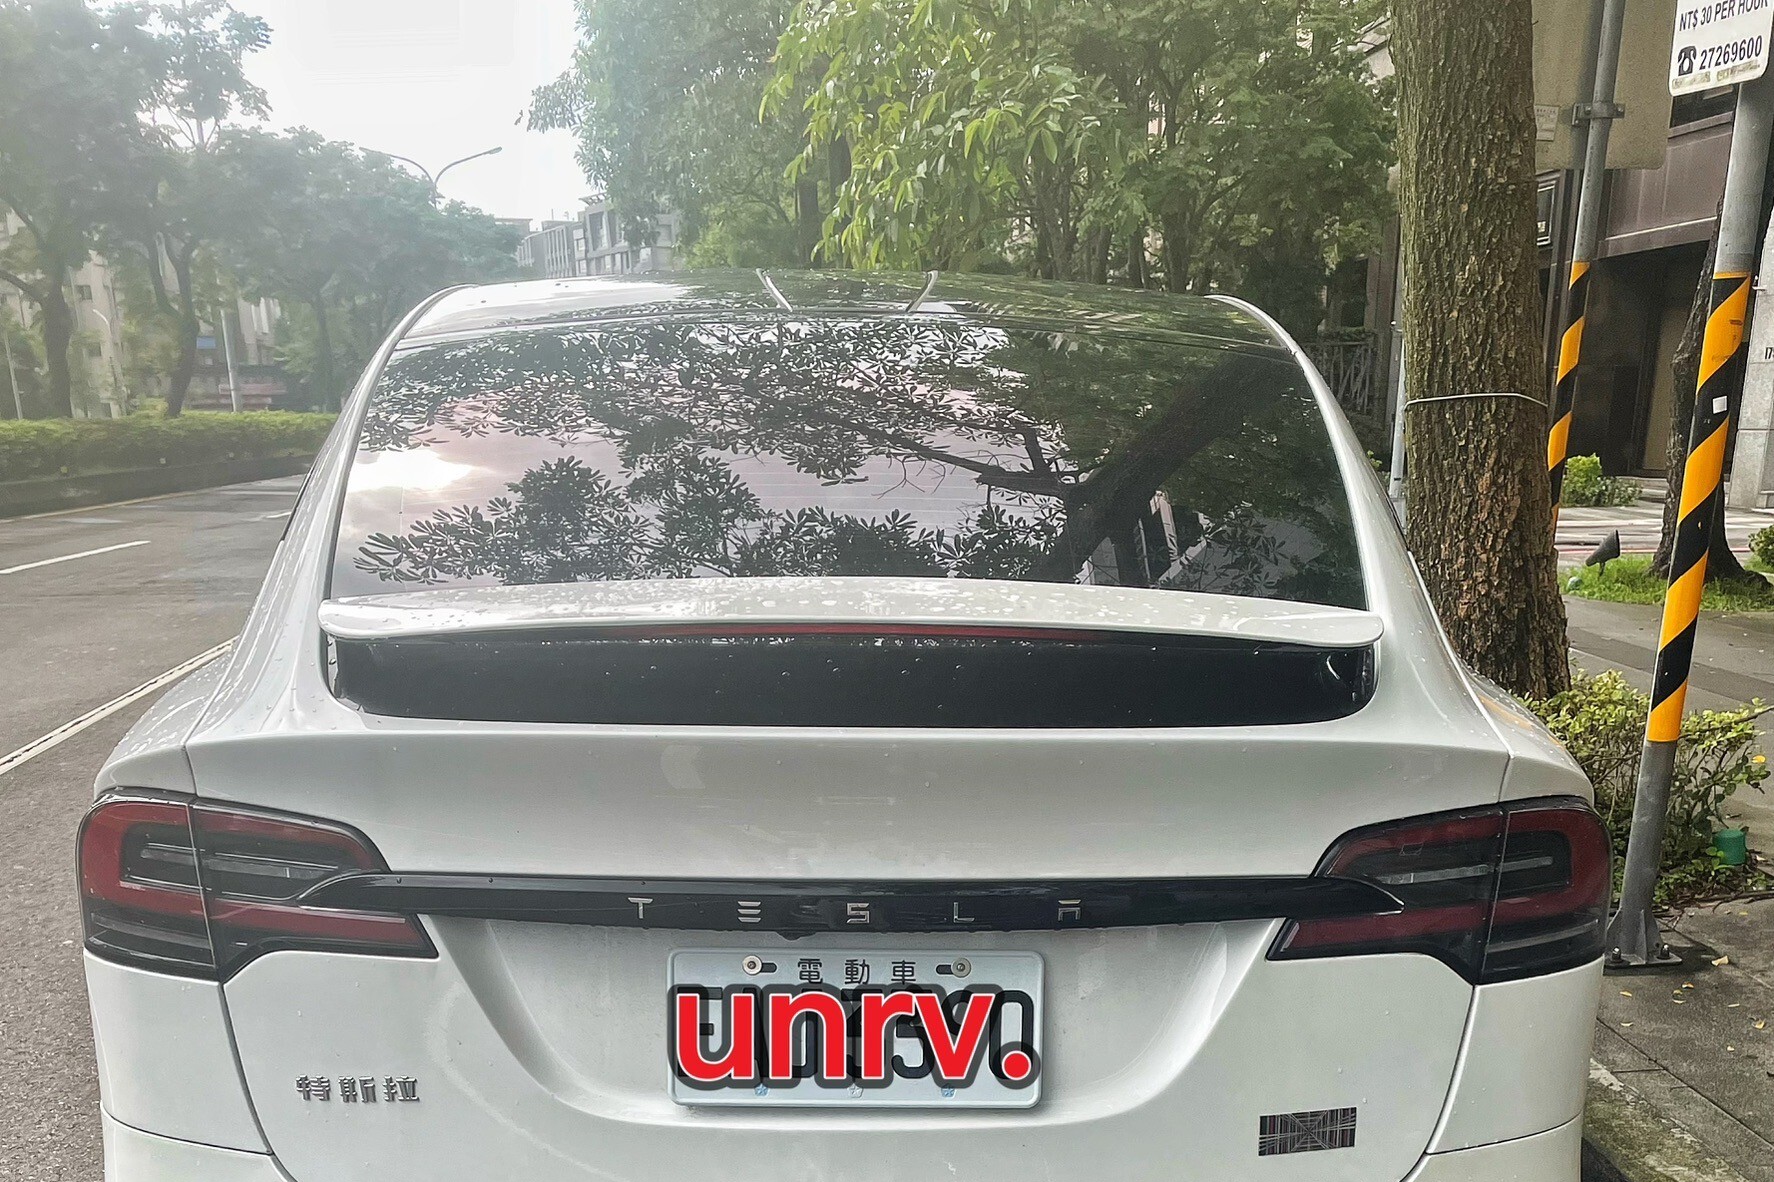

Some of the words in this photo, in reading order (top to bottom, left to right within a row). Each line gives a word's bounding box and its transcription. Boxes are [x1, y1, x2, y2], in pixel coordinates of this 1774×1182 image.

[1700, 5, 1713, 25] 30
[1714, 0, 1736, 22] PER
[1699, 35, 1763, 70] 27269600
[628, 897, 1082, 924] TESLA
[798, 958, 917, 985] 電動車
[296, 1075, 420, 1103] 特斯拉
